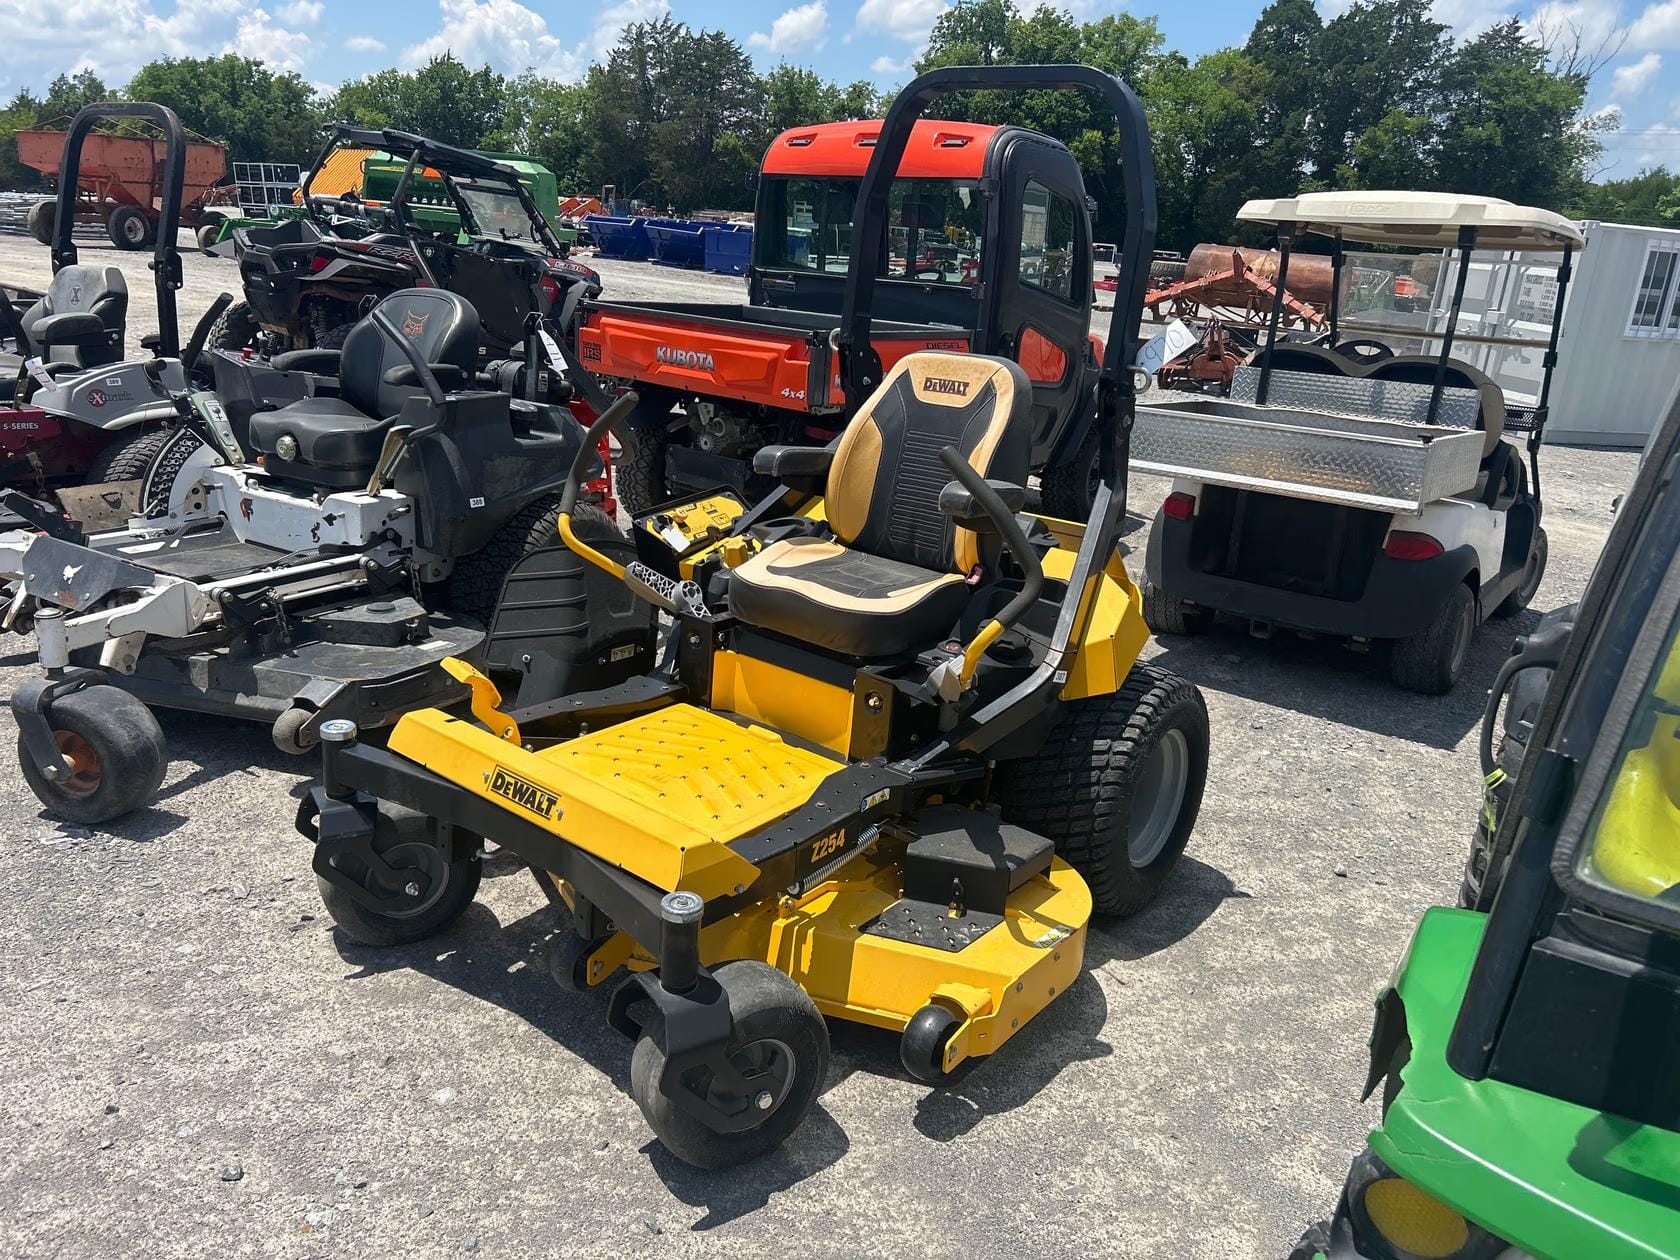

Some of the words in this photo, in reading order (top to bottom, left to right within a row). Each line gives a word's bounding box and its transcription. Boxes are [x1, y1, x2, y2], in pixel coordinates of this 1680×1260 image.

[926, 342, 964, 350] DIESEL
[584, 347, 601, 360] IRS
[656, 346, 715, 371] KUBOTA
[780, 387, 805, 400] 4x4
[3, 422, 39, 430] S-SERIES
[811, 828, 846, 863] Z254
